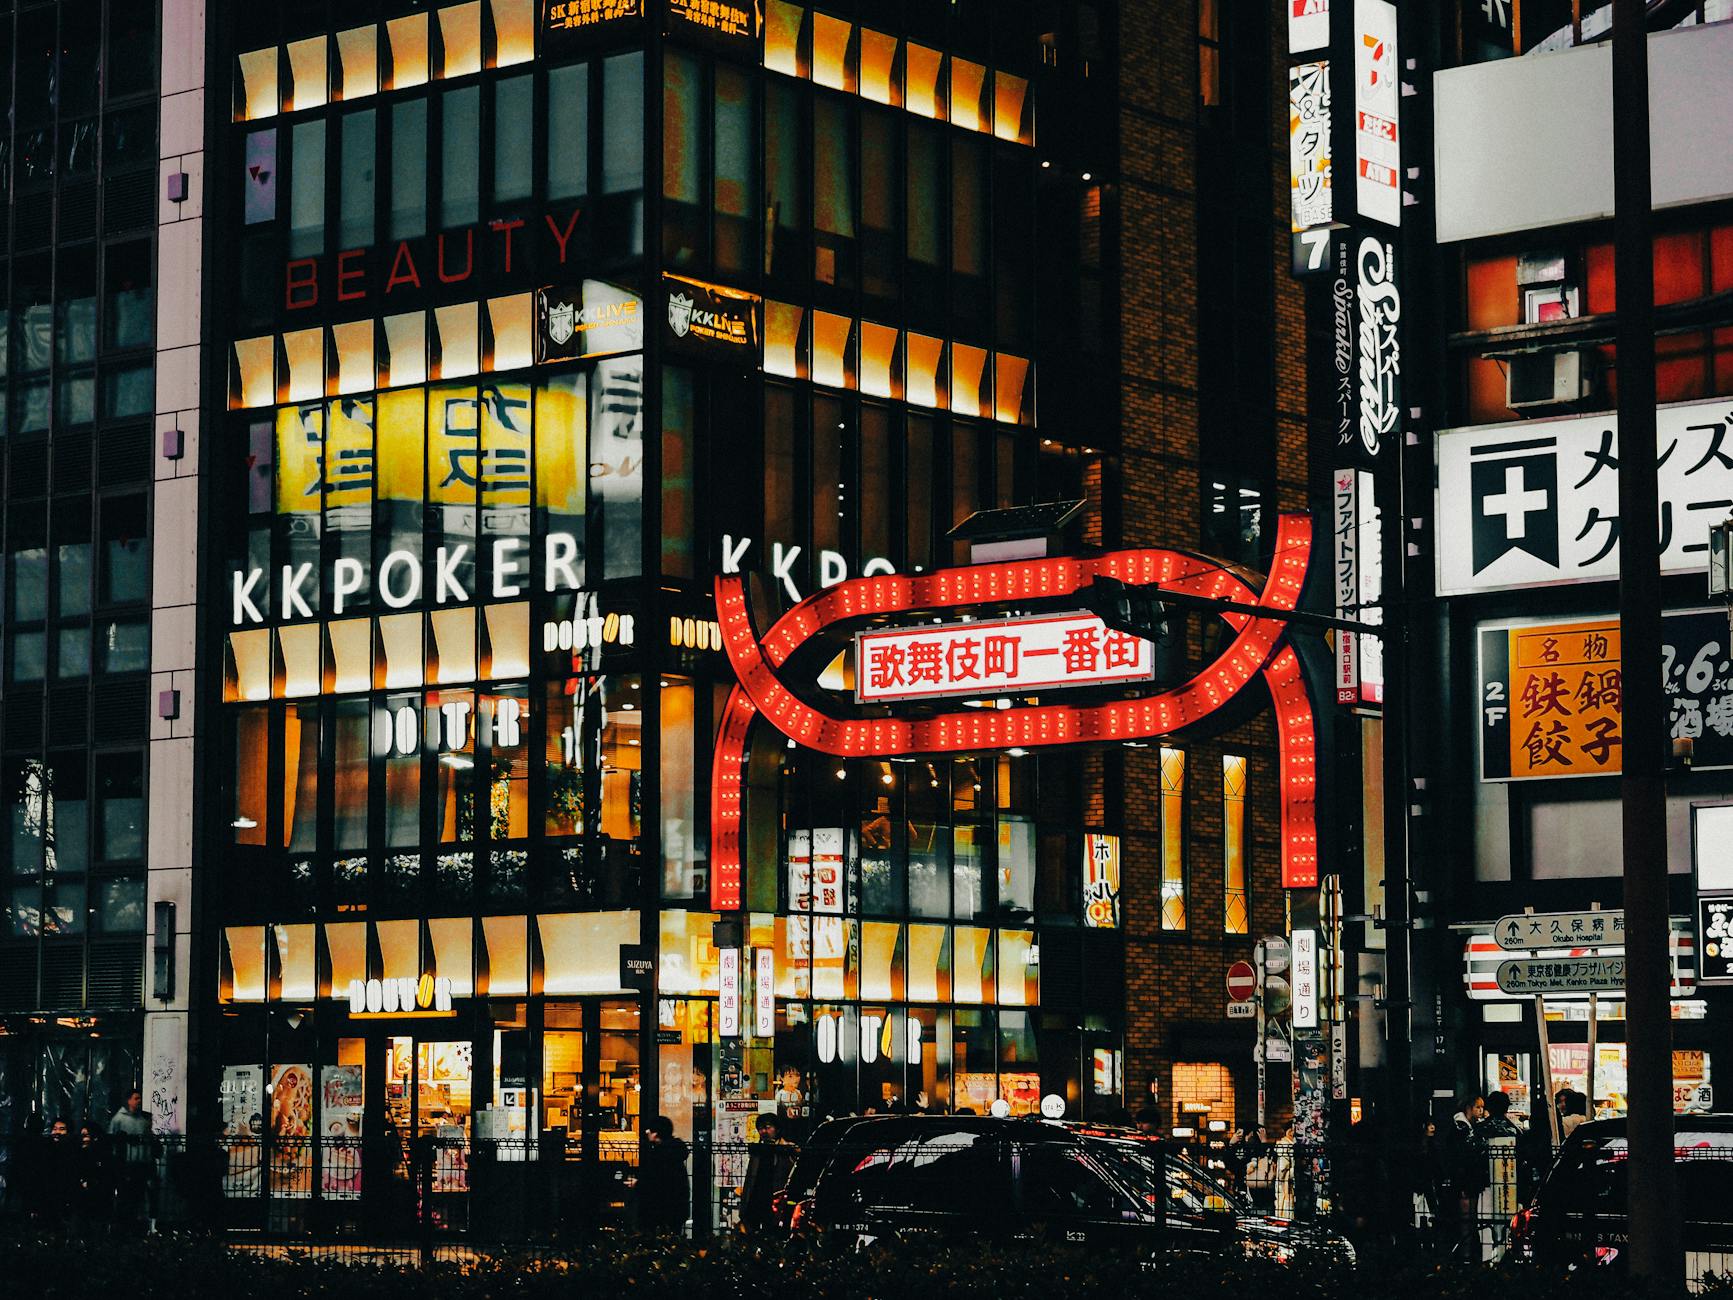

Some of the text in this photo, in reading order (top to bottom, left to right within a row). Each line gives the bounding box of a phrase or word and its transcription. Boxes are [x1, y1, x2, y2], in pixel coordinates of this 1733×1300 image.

[1366, 161, 1391, 187] ATM
[285, 209, 581, 311] BEAUTY
[1301, 229, 1330, 270] 7
[1334, 278, 1354, 374] Sparkle
[1337, 376, 1354, 446] スパークル
[232, 532, 581, 625] KKPOKER
[543, 612, 635, 652] DOUTOR
[1539, 633, 1609, 663] 名物
[870, 626, 1142, 689] 歌舞伎町一番街
[1342, 629, 1351, 684] 宿東口駅前
[1520, 669, 1622, 719] 鉄鍋
[1520, 717, 1622, 770] 餃子
[1504, 933, 1603, 945] 260m Okubo Hospital
[1529, 917, 1625, 935] 大久保病院
[627, 960, 653, 970] SUZUYA
[1297, 937, 1311, 1019] 劇場通り
[1506, 980, 1526, 988] 260m
[1527, 979, 1547, 989] Tokyo
[349, 973, 452, 1013] DOUTOR
[723, 955, 734, 1029] 劇場通り
[1550, 1048, 1572, 1070] SIM
[1698, 1087, 1712, 1102] 酒
